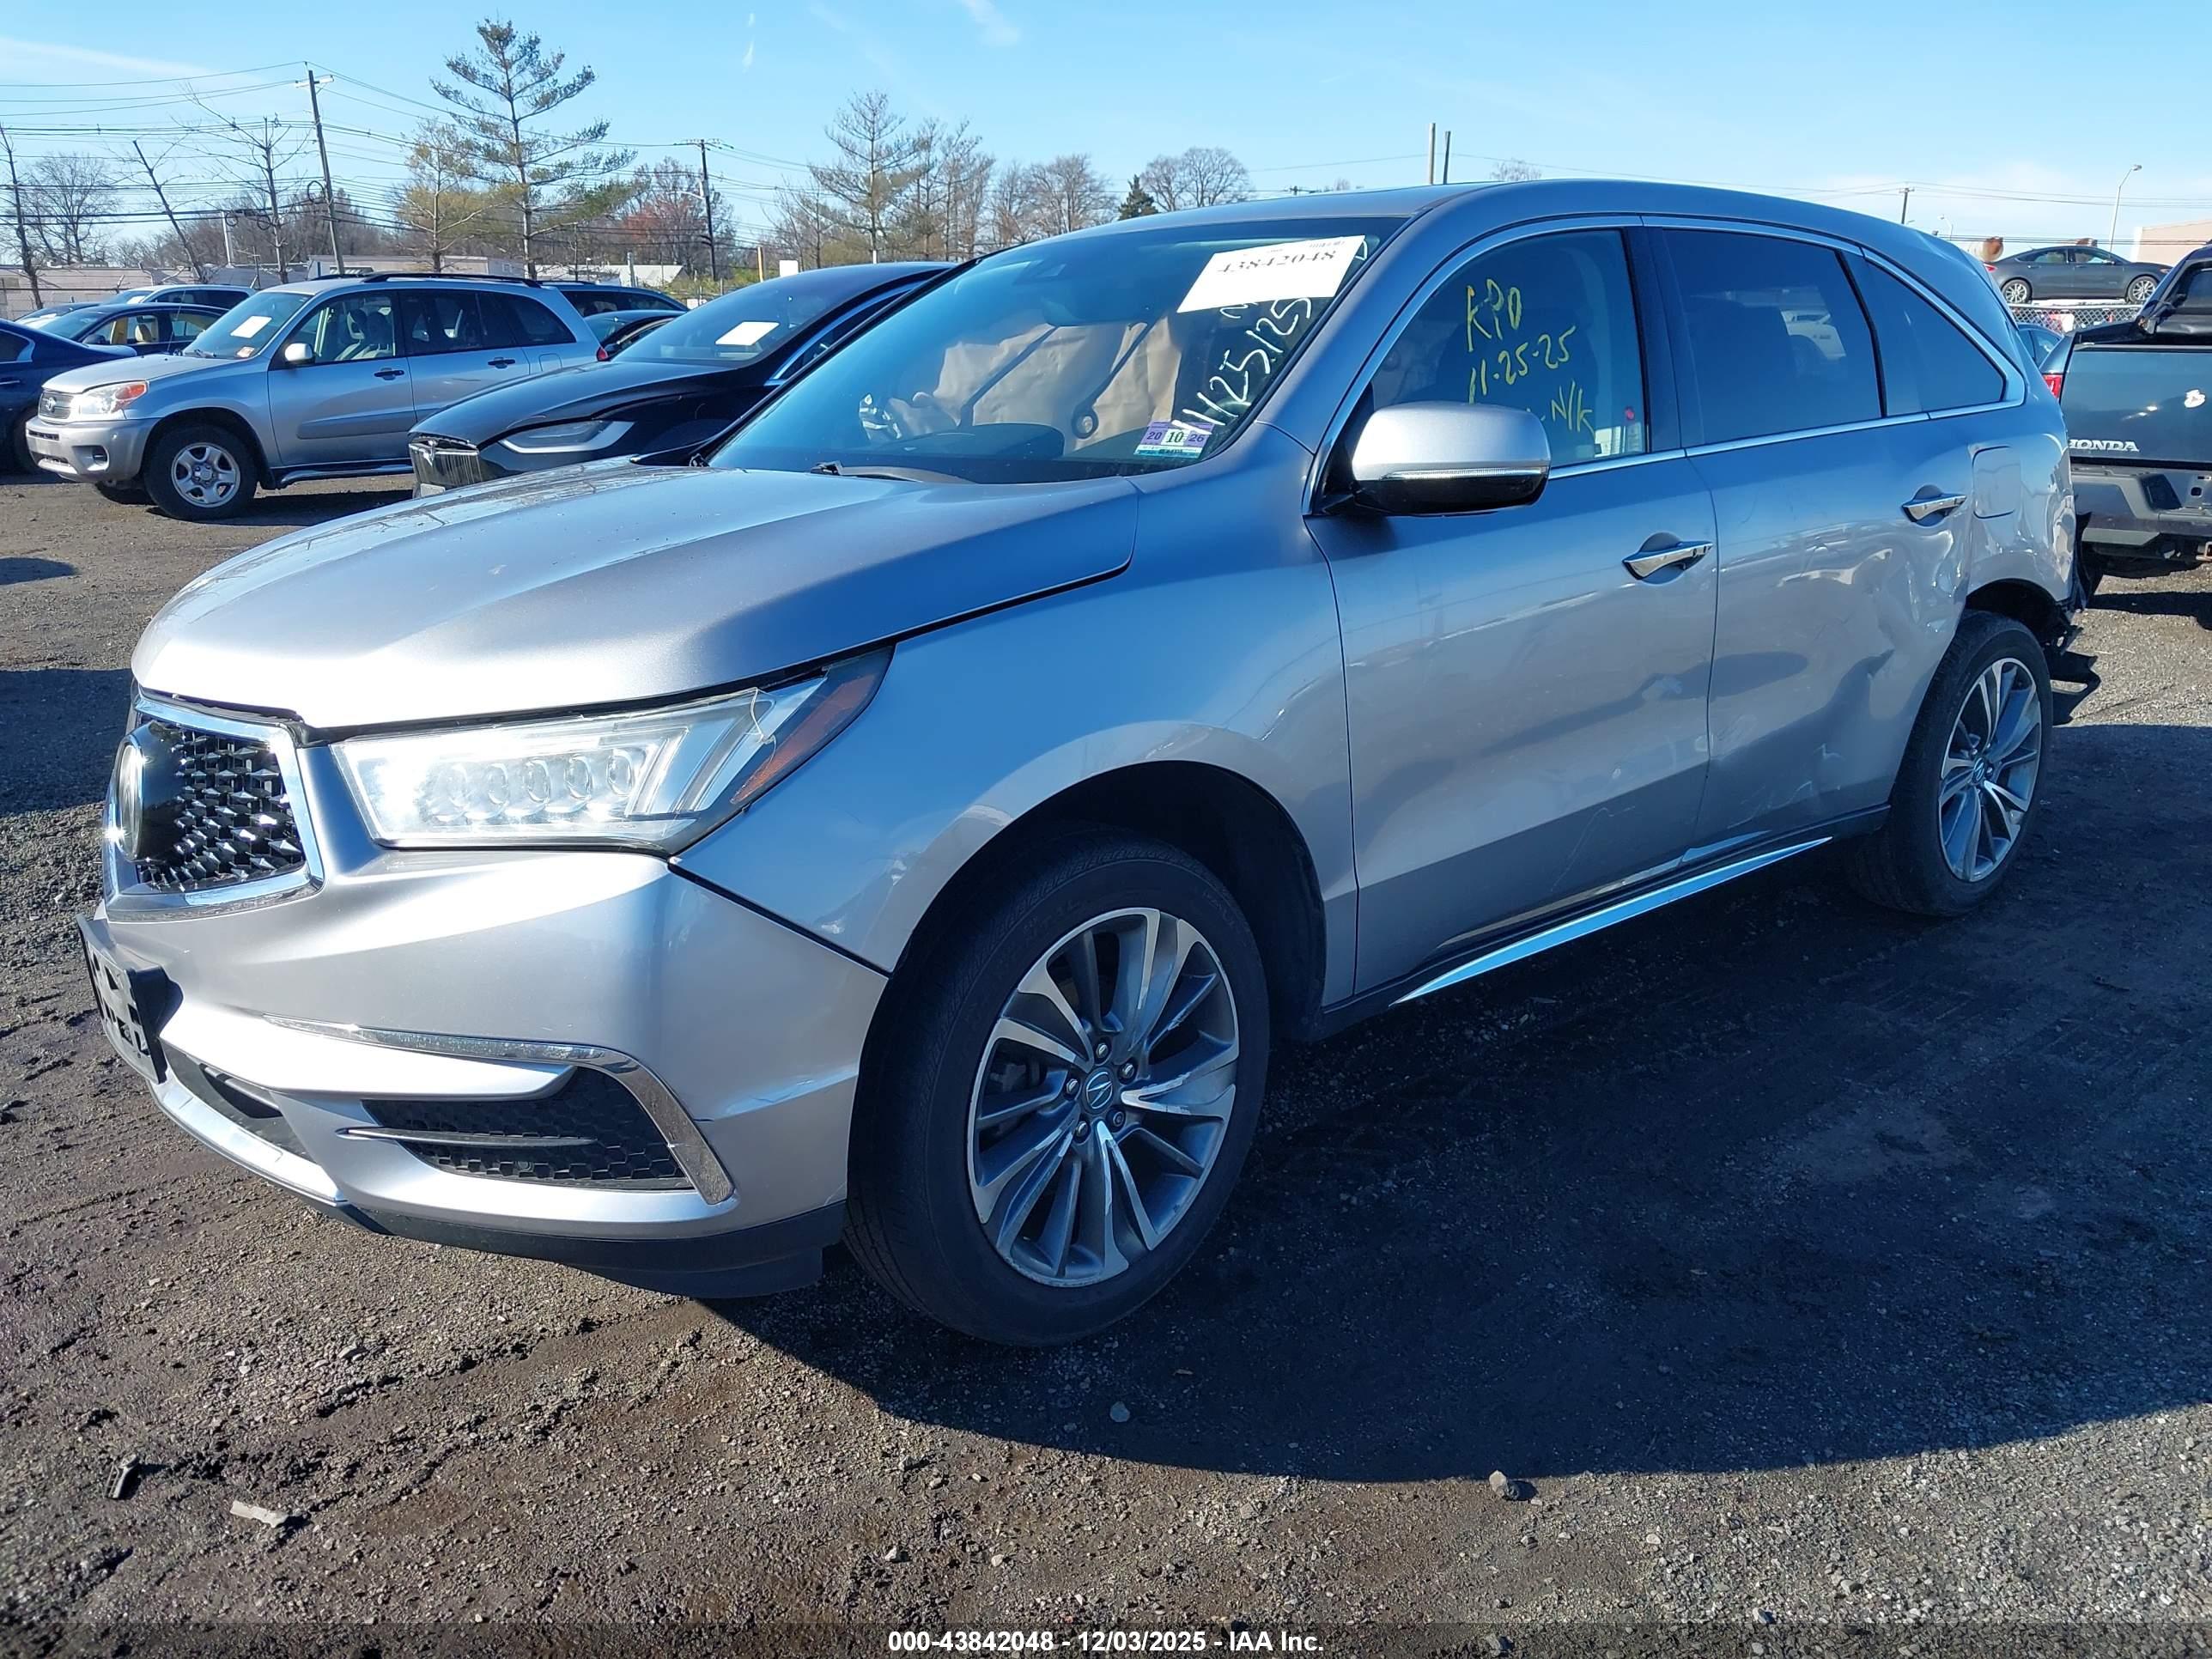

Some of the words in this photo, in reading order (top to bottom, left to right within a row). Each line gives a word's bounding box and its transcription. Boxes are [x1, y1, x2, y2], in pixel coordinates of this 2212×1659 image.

[1146, 431, 1163, 441] 20
[1165, 431, 1184, 443] 10
[1188, 434, 1204, 443] 26
